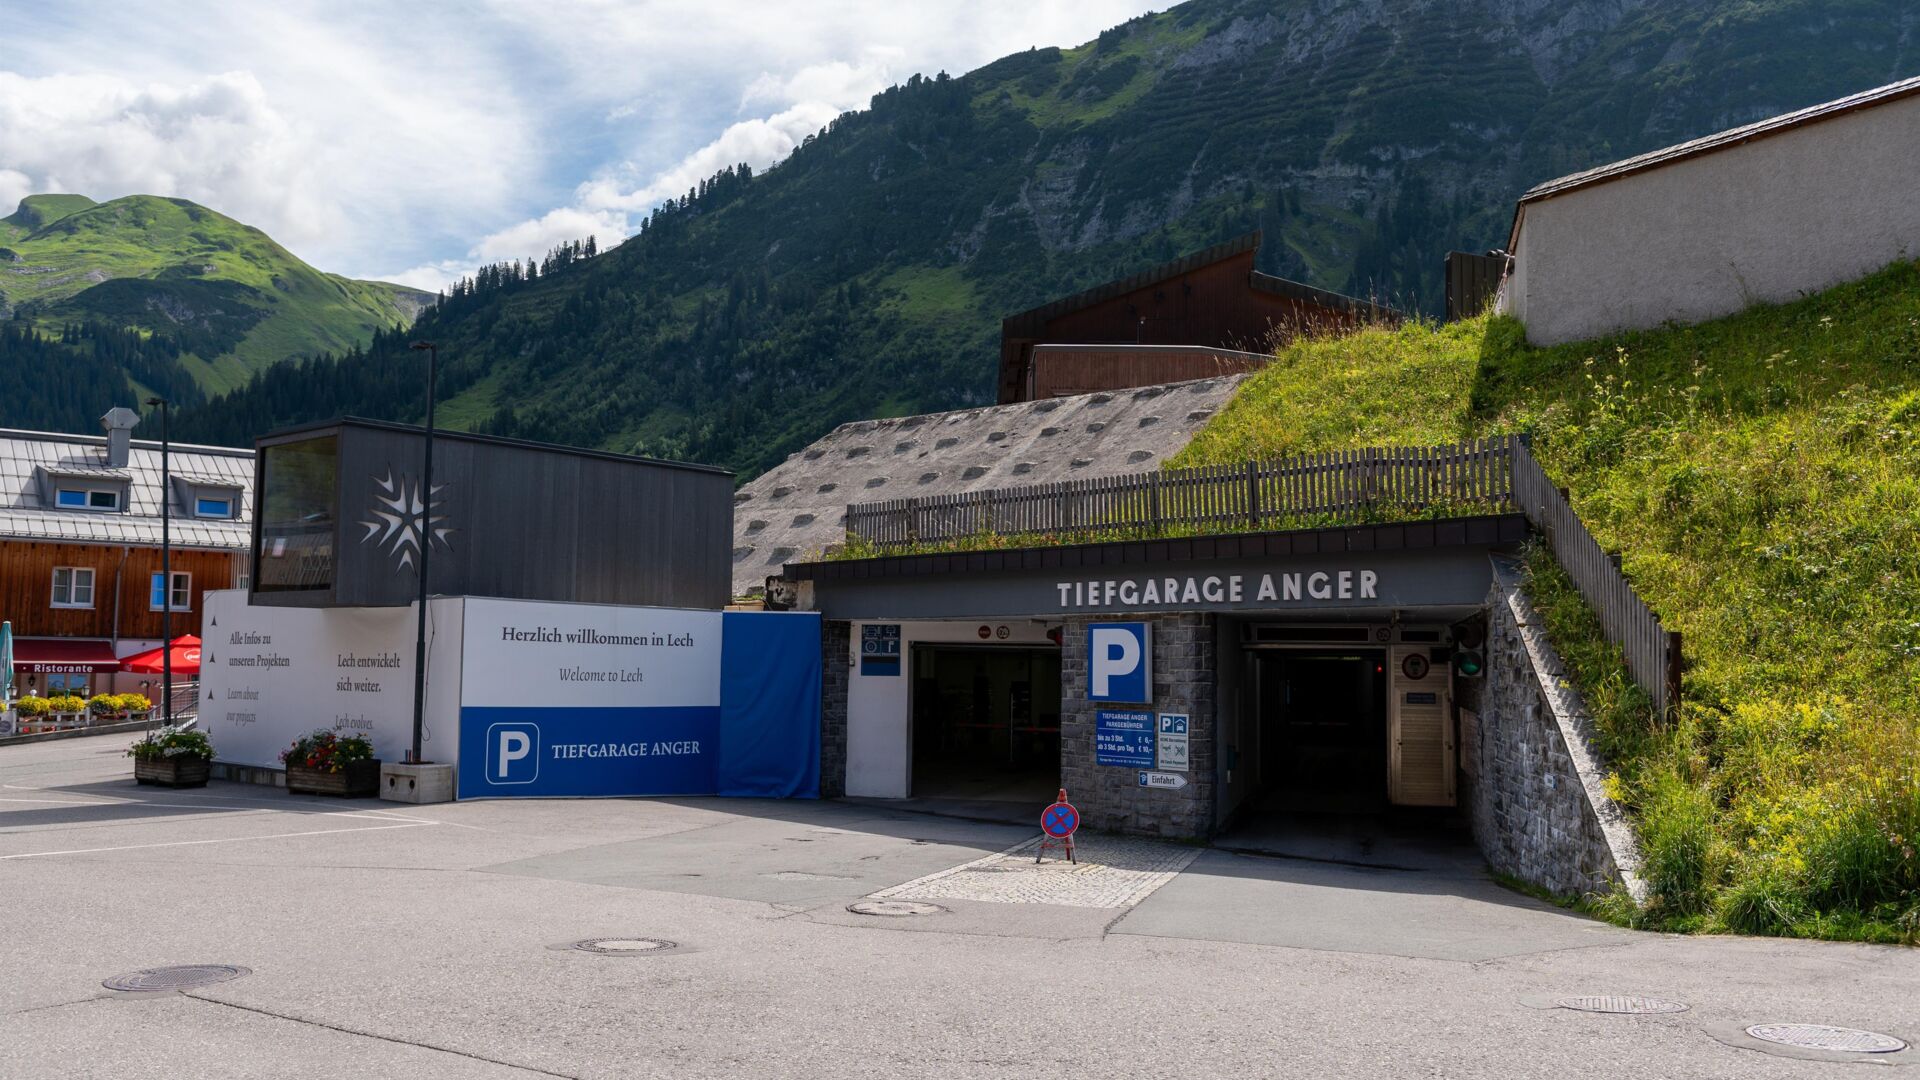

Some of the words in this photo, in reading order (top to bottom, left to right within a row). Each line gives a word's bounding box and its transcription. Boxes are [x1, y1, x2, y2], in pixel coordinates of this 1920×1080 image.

[1057, 576, 1243, 606] TIEFGARAGE
[1257, 570, 1378, 601] ANGER
[229, 631, 243, 645] Alle
[244, 630, 261, 645] Infos
[262, 636, 271, 645] zu
[502, 626, 562, 643] Herzlich
[566, 628, 648, 646] willkommen
[652, 632, 664, 646] in
[667, 632, 694, 647] Lech
[229, 656, 255, 667] unseren
[256, 653, 290, 671] Projekten
[337, 653, 356, 668] Lech
[357, 652, 401, 669] entwickelt
[1092, 628, 1140, 697] P
[34, 664, 93, 673] Ristorante
[559, 666, 606, 682] Welcome
[608, 669, 618, 682] to
[620, 667, 643, 683] Lech
[336, 677, 352, 692] sich
[353, 679, 381, 692] weiter.
[227, 687, 242, 700] Learn
[243, 687, 259, 700] about
[226, 712, 234, 722] our
[235, 709, 256, 724] projects
[336, 714, 348, 729] Lech
[1102, 713, 1130, 721] TIEFGARAGE
[1106, 721, 1143, 729] PARKGEBÜHREN
[1162, 718, 1171, 731] P
[1138, 736, 1142, 744] €
[498, 730, 531, 778] P
[552, 743, 647, 759] TIEFGARAGE
[651, 741, 700, 756] ANGER
[1107, 743, 1117, 751] Std.
[1126, 744, 1134, 753] Tag
[1138, 745, 1142, 753] €
[1152, 775, 1176, 785] Einfahrt
